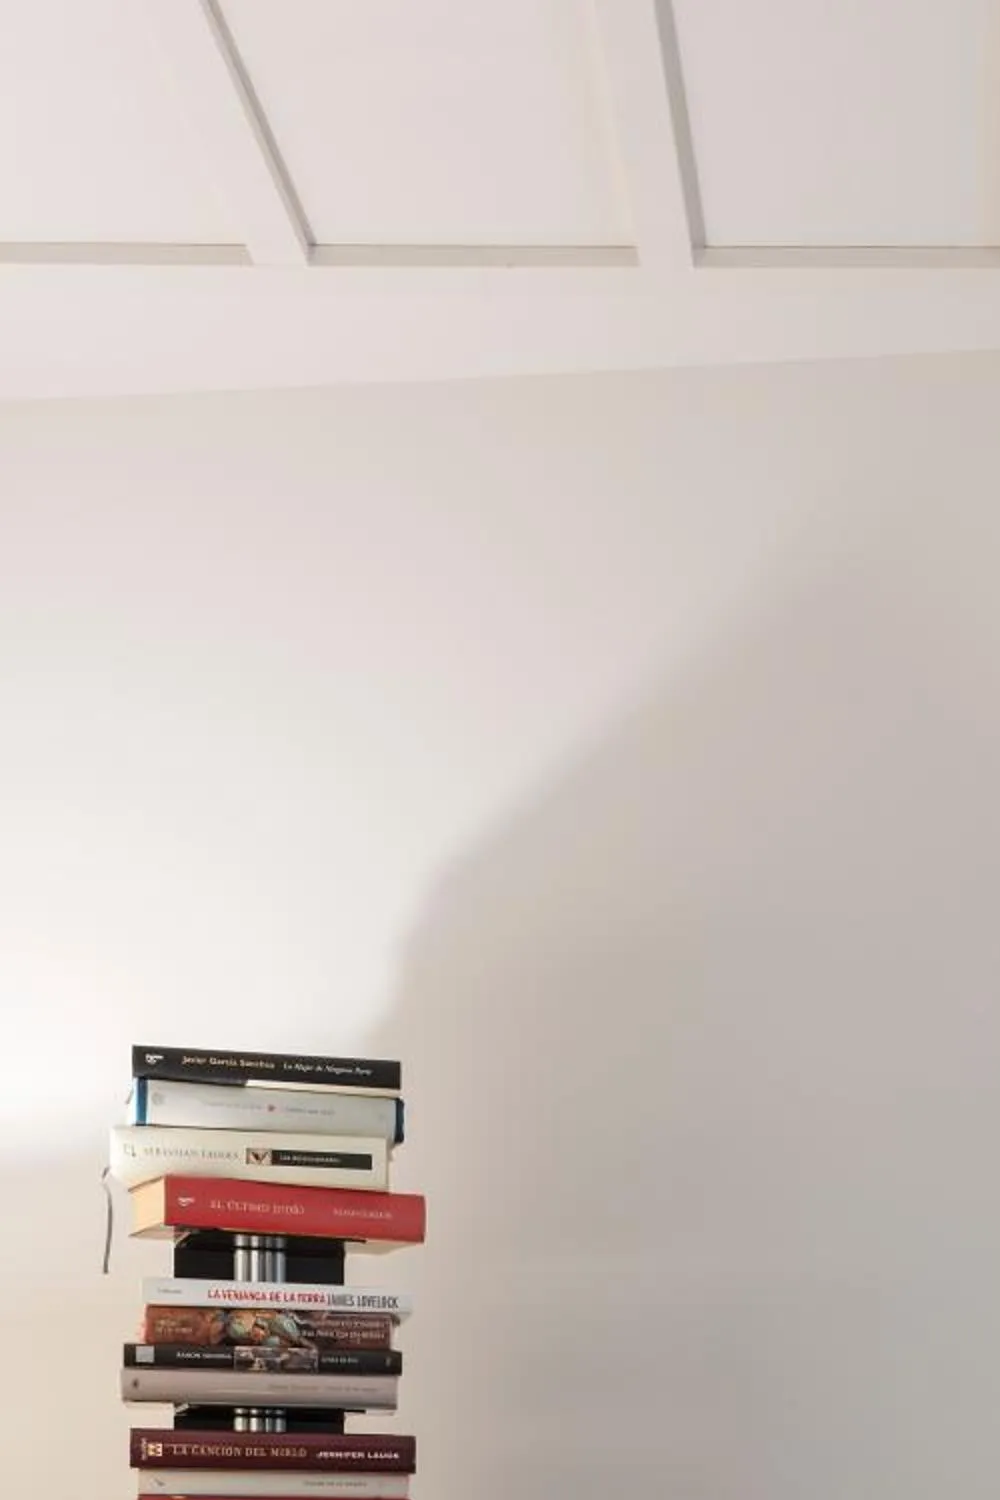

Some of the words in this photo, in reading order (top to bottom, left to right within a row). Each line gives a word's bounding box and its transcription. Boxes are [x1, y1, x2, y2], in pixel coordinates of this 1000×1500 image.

[208, 1288, 219, 1299] LA
[269, 1291, 281, 1302] DE
[284, 1292, 295, 1303] LA
[245, 1447, 267, 1457] DEL
